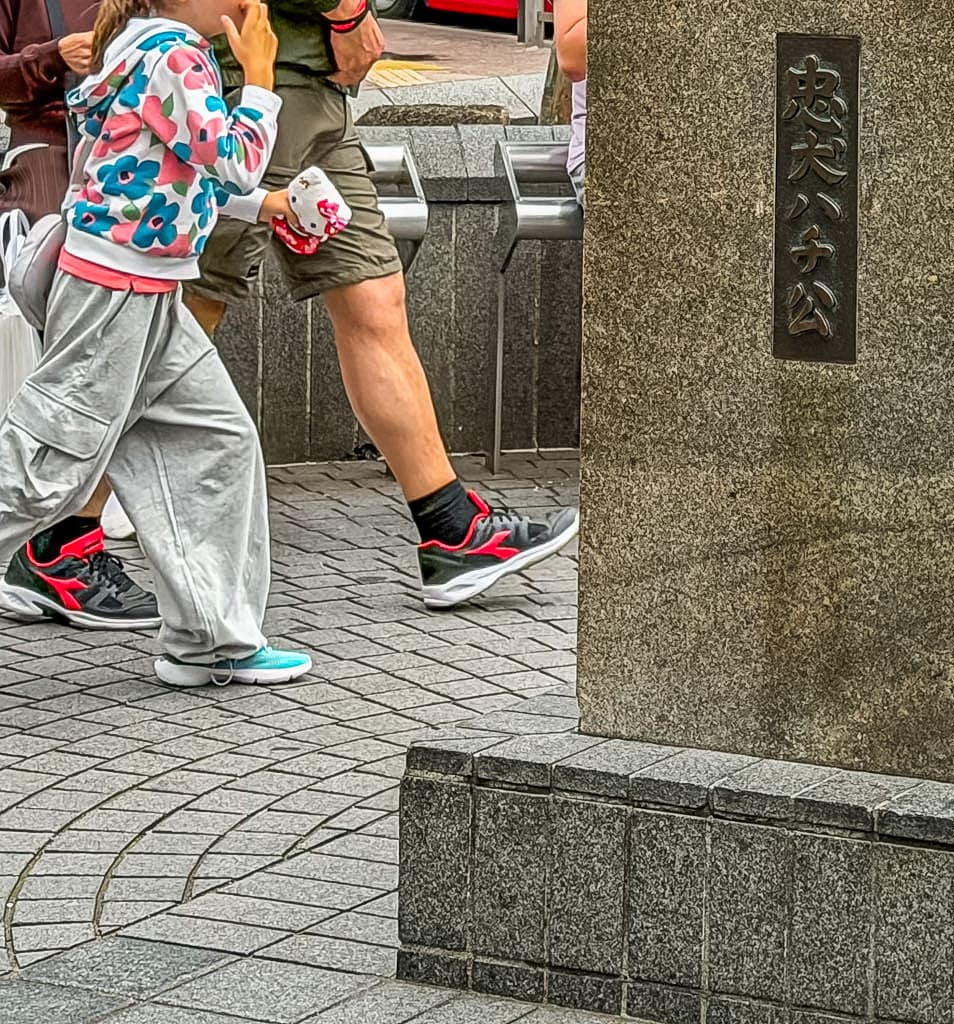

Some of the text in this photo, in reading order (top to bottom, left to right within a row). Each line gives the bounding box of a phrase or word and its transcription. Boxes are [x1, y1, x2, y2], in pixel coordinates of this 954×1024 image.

[783, 54, 848, 338] 忠犬ハチ公
